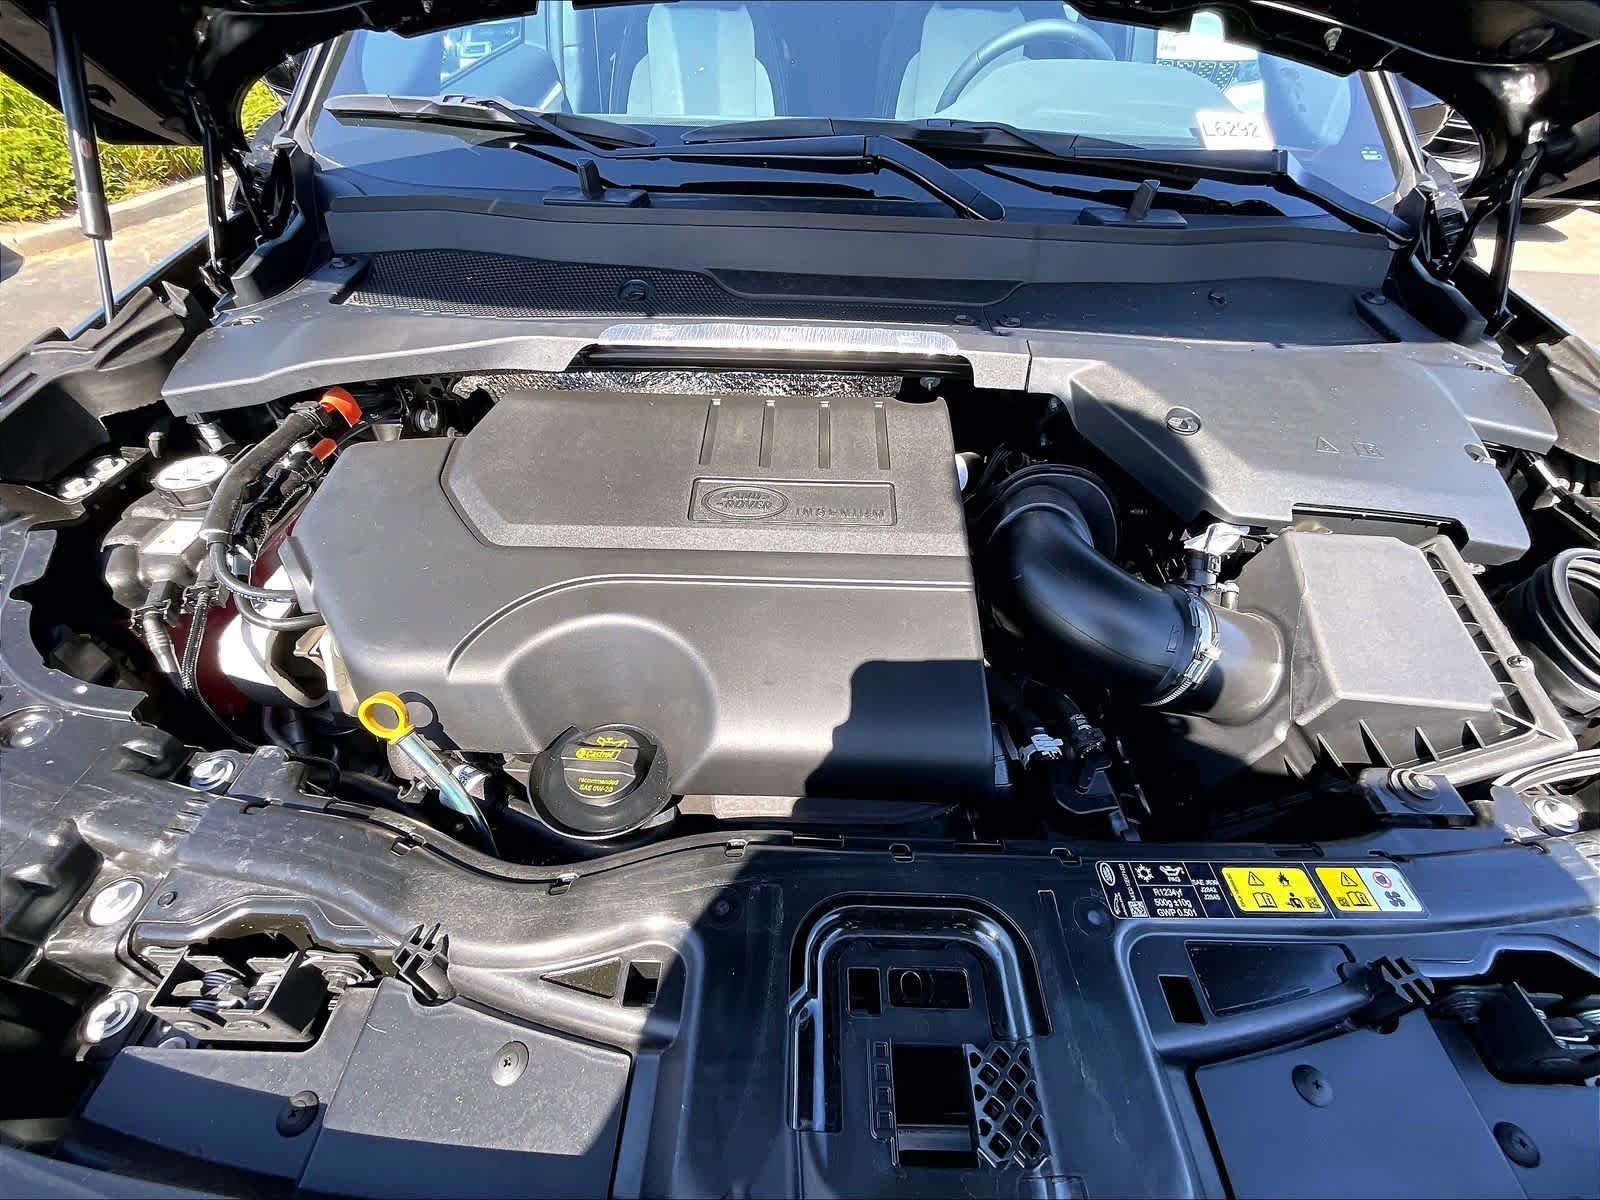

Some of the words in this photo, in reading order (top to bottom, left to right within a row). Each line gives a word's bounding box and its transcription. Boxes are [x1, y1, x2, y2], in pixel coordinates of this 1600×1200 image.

[586, 750, 615, 759] Castrol
[578, 777, 619, 785] recommended
[1153, 888, 1183, 897] R1234yf
[1154, 898, 1173, 908] 500g
[1157, 908, 1176, 917] GWP
[1177, 909, 1198, 917] 0.501
